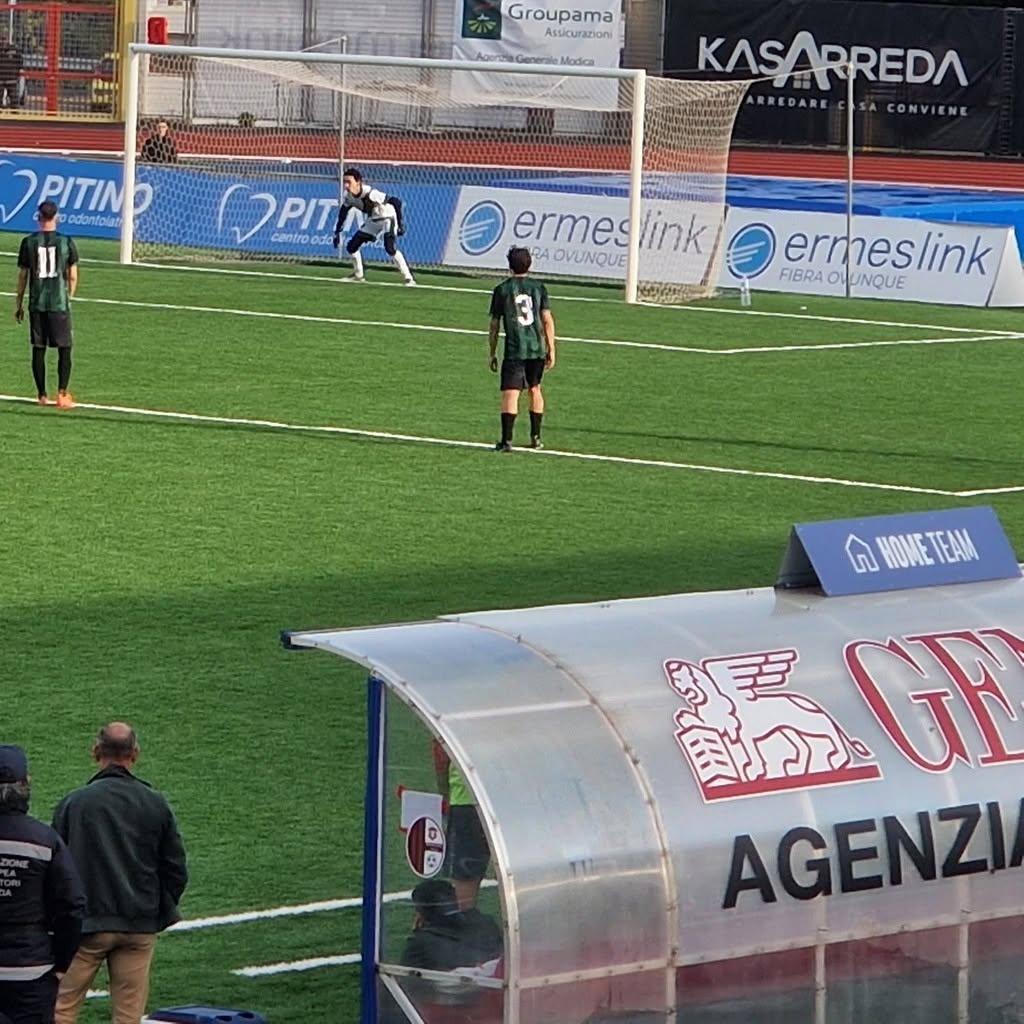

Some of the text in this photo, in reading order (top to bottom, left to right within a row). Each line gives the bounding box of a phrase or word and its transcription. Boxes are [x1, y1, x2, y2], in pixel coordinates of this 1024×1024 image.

[508, 4, 613, 24] Groupama
[545, 27, 613, 40] Assicurazioni
[516, 54, 558, 65] Generale
[560, 56, 595, 67] Modica
[697, 30, 969, 91] KASARREDA
[746, 94, 828, 110] ARREDARE
[887, 103, 969, 117] CONVIENE
[38, 174, 154, 216] PITINO
[68, 213, 140, 229] odontoiatr
[277, 197, 365, 233] PITN
[271, 232, 310, 244] centro
[513, 209, 708, 256] ermeslink
[37, 246, 57, 278] 11
[552, 248, 628, 268] OVUNQUE
[784, 230, 993, 276] ermeslink
[778, 268, 823, 284] FIBRA
[514, 293, 534, 326] 3
[876, 528, 980, 569] HOME TEAM
